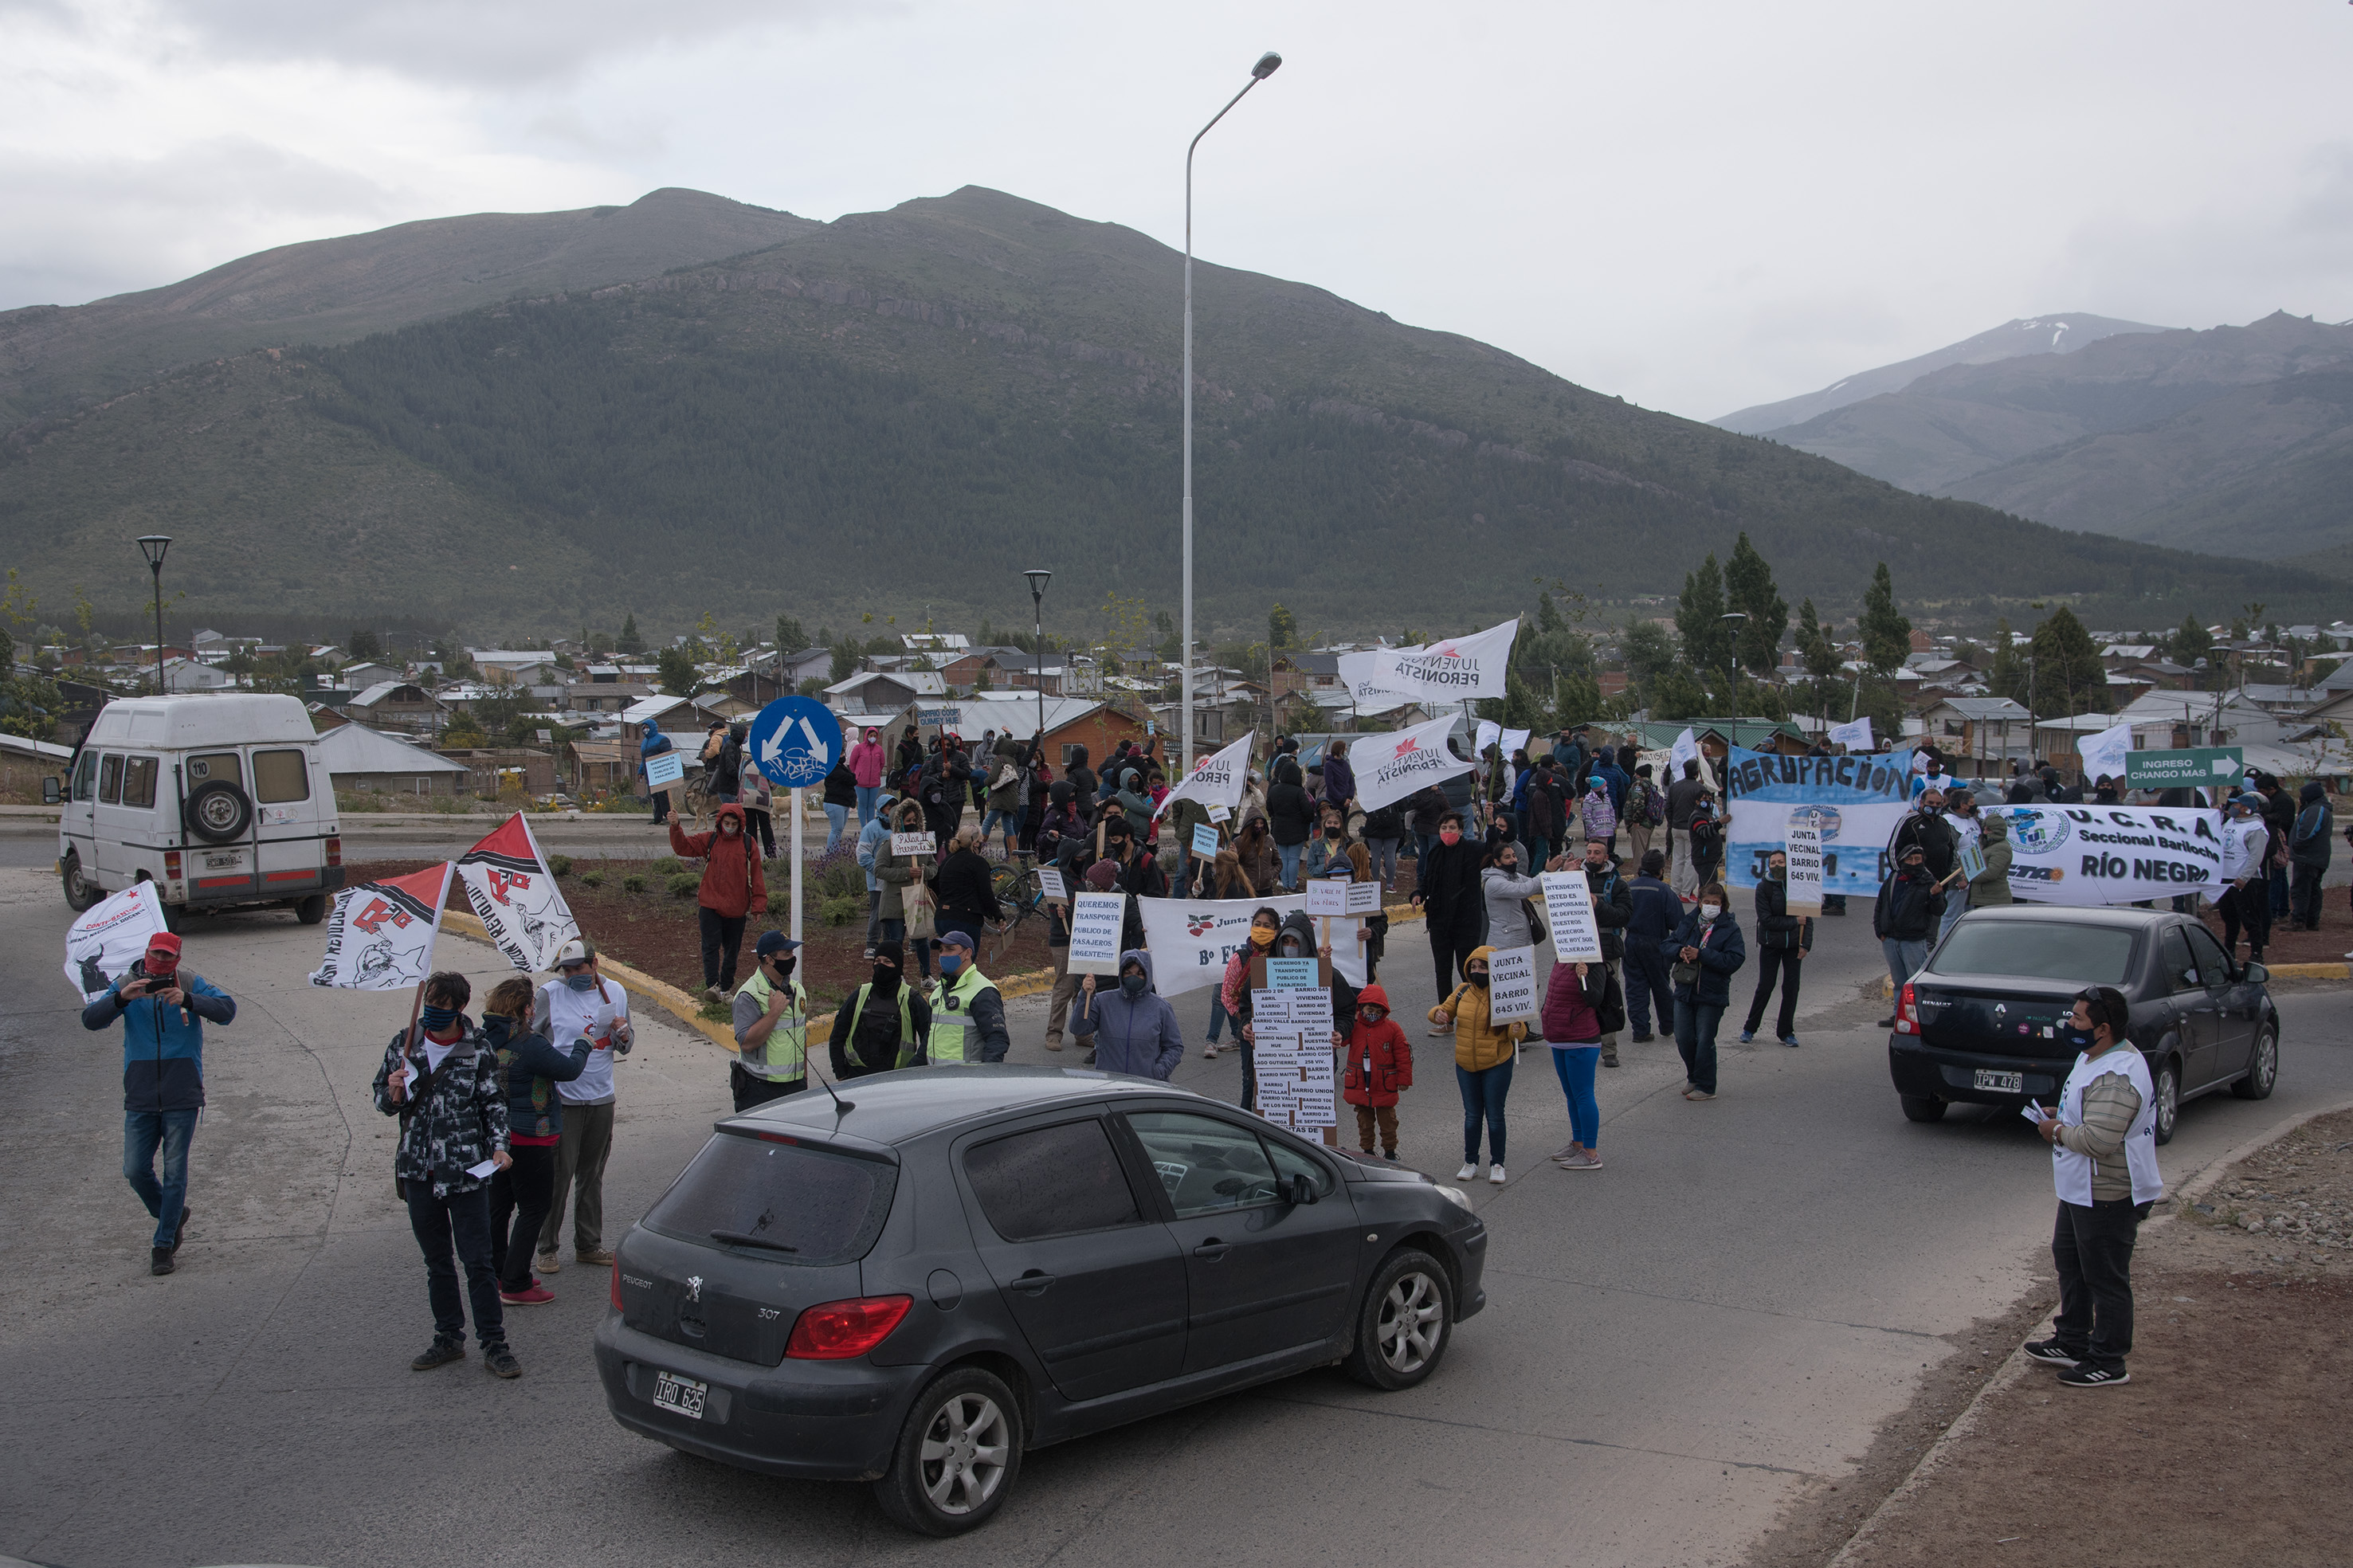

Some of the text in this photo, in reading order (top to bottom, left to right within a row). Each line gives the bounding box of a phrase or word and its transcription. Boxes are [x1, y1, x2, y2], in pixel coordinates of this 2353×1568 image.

[193, 762, 207, 775] 110
[2143, 759, 2193, 768] INGRESO
[2131, 769, 2206, 779] CHANGO MAS
[2065, 809, 2104, 825] U.
[2108, 811, 2147, 829] C.
[2149, 814, 2187, 833] R.
[2194, 816, 2221, 845] A.
[898, 833, 920, 844] Pilar
[1792, 830, 1816, 841] JUNTA
[1788, 844, 1821, 854] VECINAL
[2079, 829, 2220, 864] Seccional Bariloche
[206, 857, 236, 867] SWR 503
[1791, 857, 1819, 868] BARRIO
[2080, 852, 2209, 883] RÍO NEGRO
[1791, 872, 1819, 881] 645 VIV.
[1217, 917, 1248, 928] Junta
[1071, 950, 1113, 958] URGENTE!!!!!
[1494, 956, 1523, 967] JUNTA
[1492, 970, 1531, 982] VECINAL
[1495, 988, 1528, 1000] BARRIO
[1496, 1002, 1531, 1014] 645 VIV.
[1976, 1074, 2021, 1089] IPW 478
[622, 1274, 653, 1290] PEUGEOT
[758, 1308, 781, 1320] 307
[656, 1380, 679, 1403] IRO
[682, 1388, 703, 1411] 625
